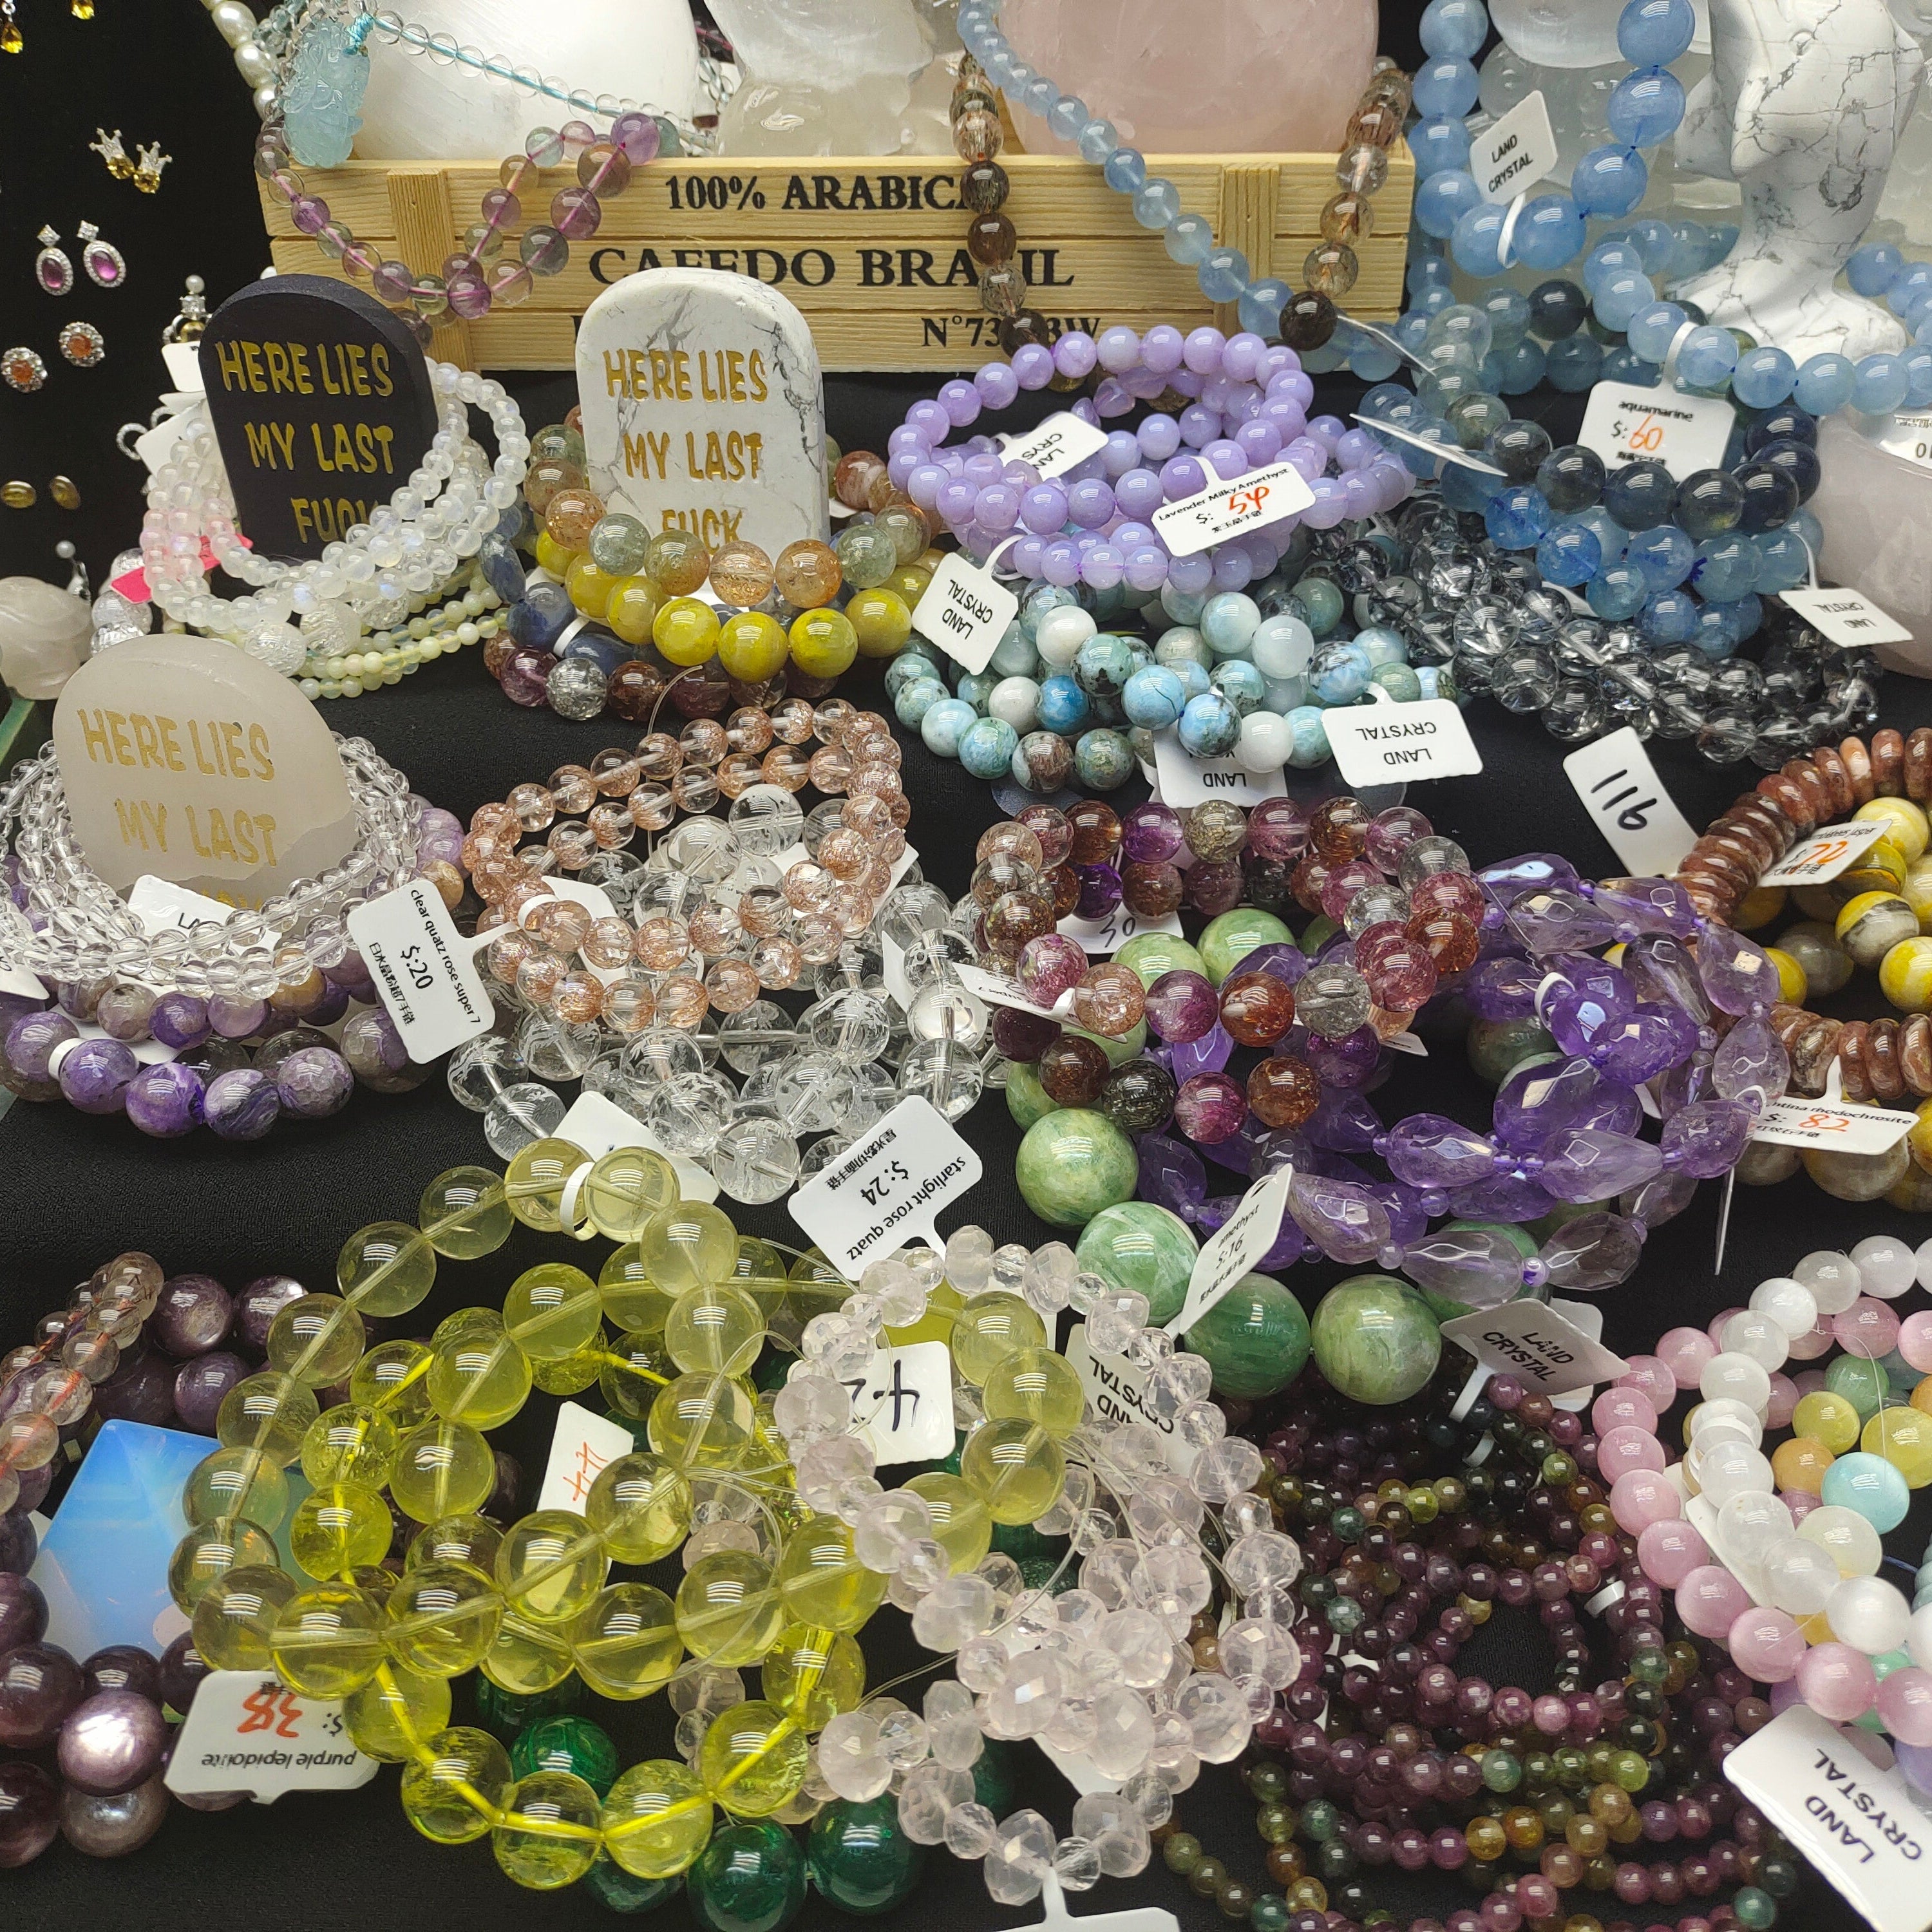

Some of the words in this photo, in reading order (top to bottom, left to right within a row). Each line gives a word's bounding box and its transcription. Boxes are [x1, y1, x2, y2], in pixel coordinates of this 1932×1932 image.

[1492, 135, 1517, 163] LAND
[1488, 152, 1533, 193] CRYSTAL
[666, 175, 766, 210] 100%
[782, 175, 967, 211] ARABIC
[857, 249, 1075, 287] BRAIL
[215, 341, 314, 394] HERE
[317, 343, 393, 397] LIES
[603, 348, 694, 402] HERE
[699, 348, 768, 403] LIES
[245, 422, 294, 470] MY
[311, 422, 393, 474] LAST
[623, 431, 670, 480] MY
[686, 431, 763, 482] LAST
[1022, 433, 1062, 460] CRYS
[1032, 448, 1065, 470] LAN
[1159, 498, 1206, 520] Lavender
[1208, 486, 1236, 502] Milky
[1238, 468, 1290, 489] Amethyst
[947, 579, 993, 624] CRYSTAL
[942, 609, 974, 639] LAND
[77, 708, 186, 772] HERE
[187, 719, 276, 782] LIES
[1355, 721, 1437, 741] CRYSTAL
[1383, 748, 1433, 765] LAND
[1203, 773, 1247, 787] LAND
[114, 798, 169, 853] MY
[185, 804, 278, 867] LAST
[411, 889, 430, 919] clear
[424, 920, 446, 954] quatz
[442, 954, 459, 981] rose
[453, 982, 475, 1016] super
[1798, 1113, 1850, 1132] 82
[860, 1175, 890, 1207] 24
[911, 1156, 966, 1205] starlight
[883, 1200, 914, 1227] rose
[846, 1225, 884, 1262] quatz
[1482, 1331, 1556, 1381] CRYSTAL
[1521, 1332, 1574, 1363] LAND
[202, 1750, 292, 1769] lepidolite
[296, 1750, 357, 1770] purple
[1814, 1748, 1922, 1860] CRYSTAL
[1804, 1795, 1874, 1863] LAND
